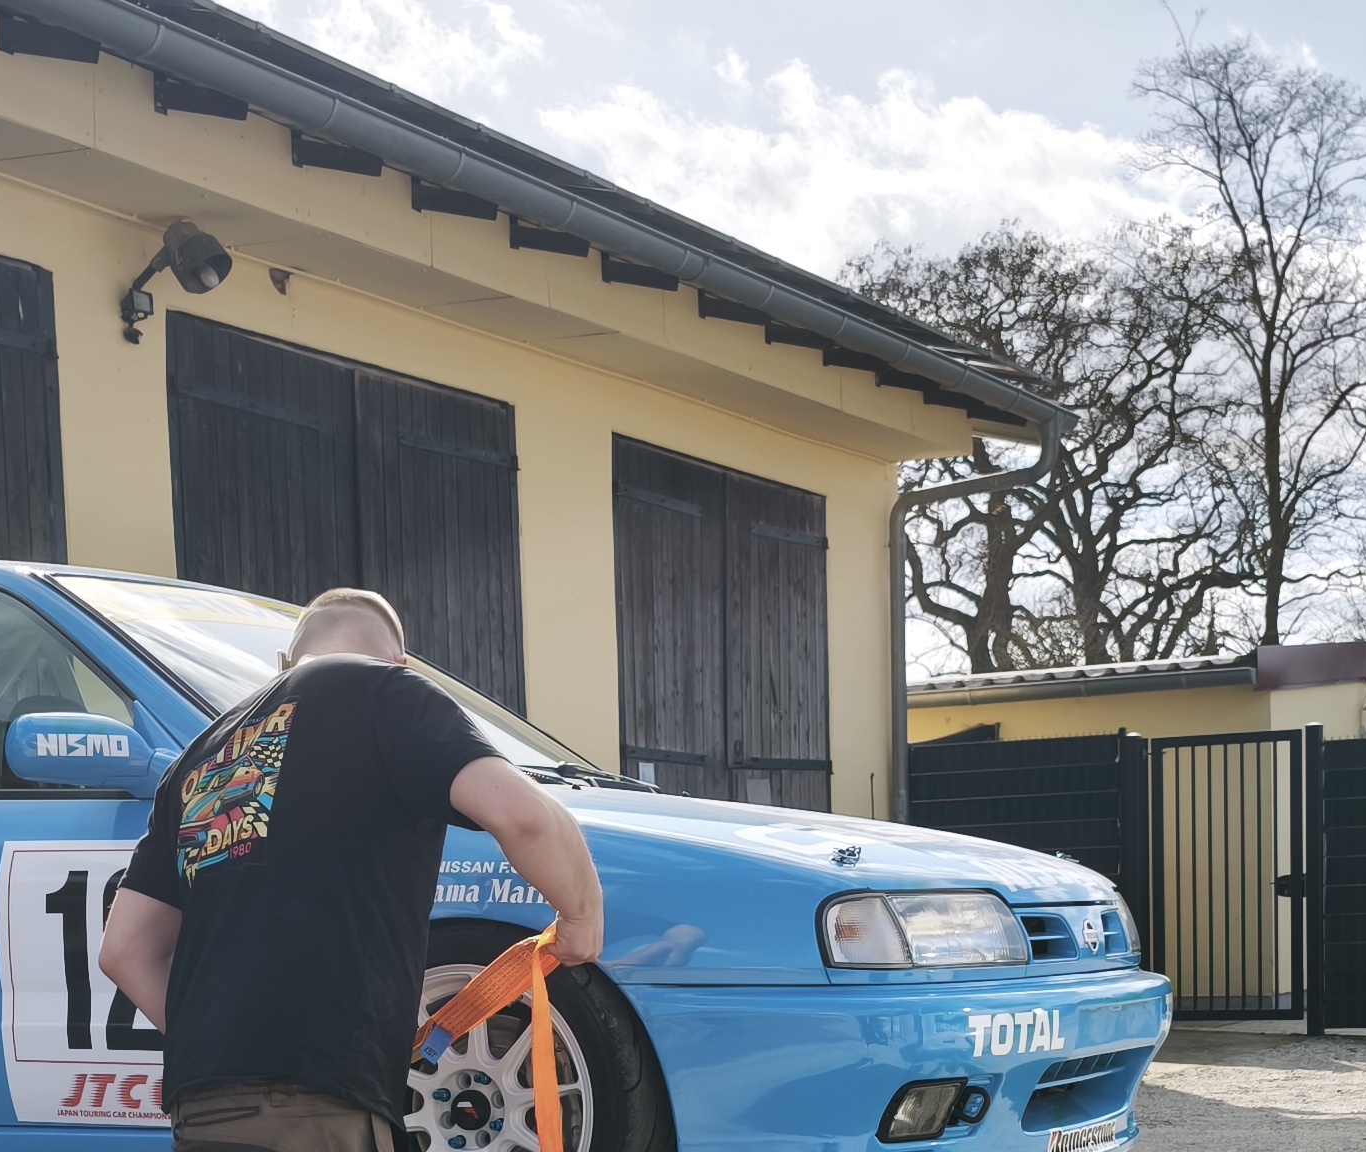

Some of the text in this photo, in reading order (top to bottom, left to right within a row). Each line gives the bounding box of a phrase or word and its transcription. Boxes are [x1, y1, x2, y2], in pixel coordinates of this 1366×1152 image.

[36, 733, 130, 758] NISMO
[206, 814, 254, 856] DAYS
[230, 841, 252, 860] 1980
[968, 1009, 1065, 1058] TOTAL
[57, 1109, 79, 1117] JAPAN
[80, 1110, 112, 1118] TOURING
[112, 1111, 127, 1119] CAR
